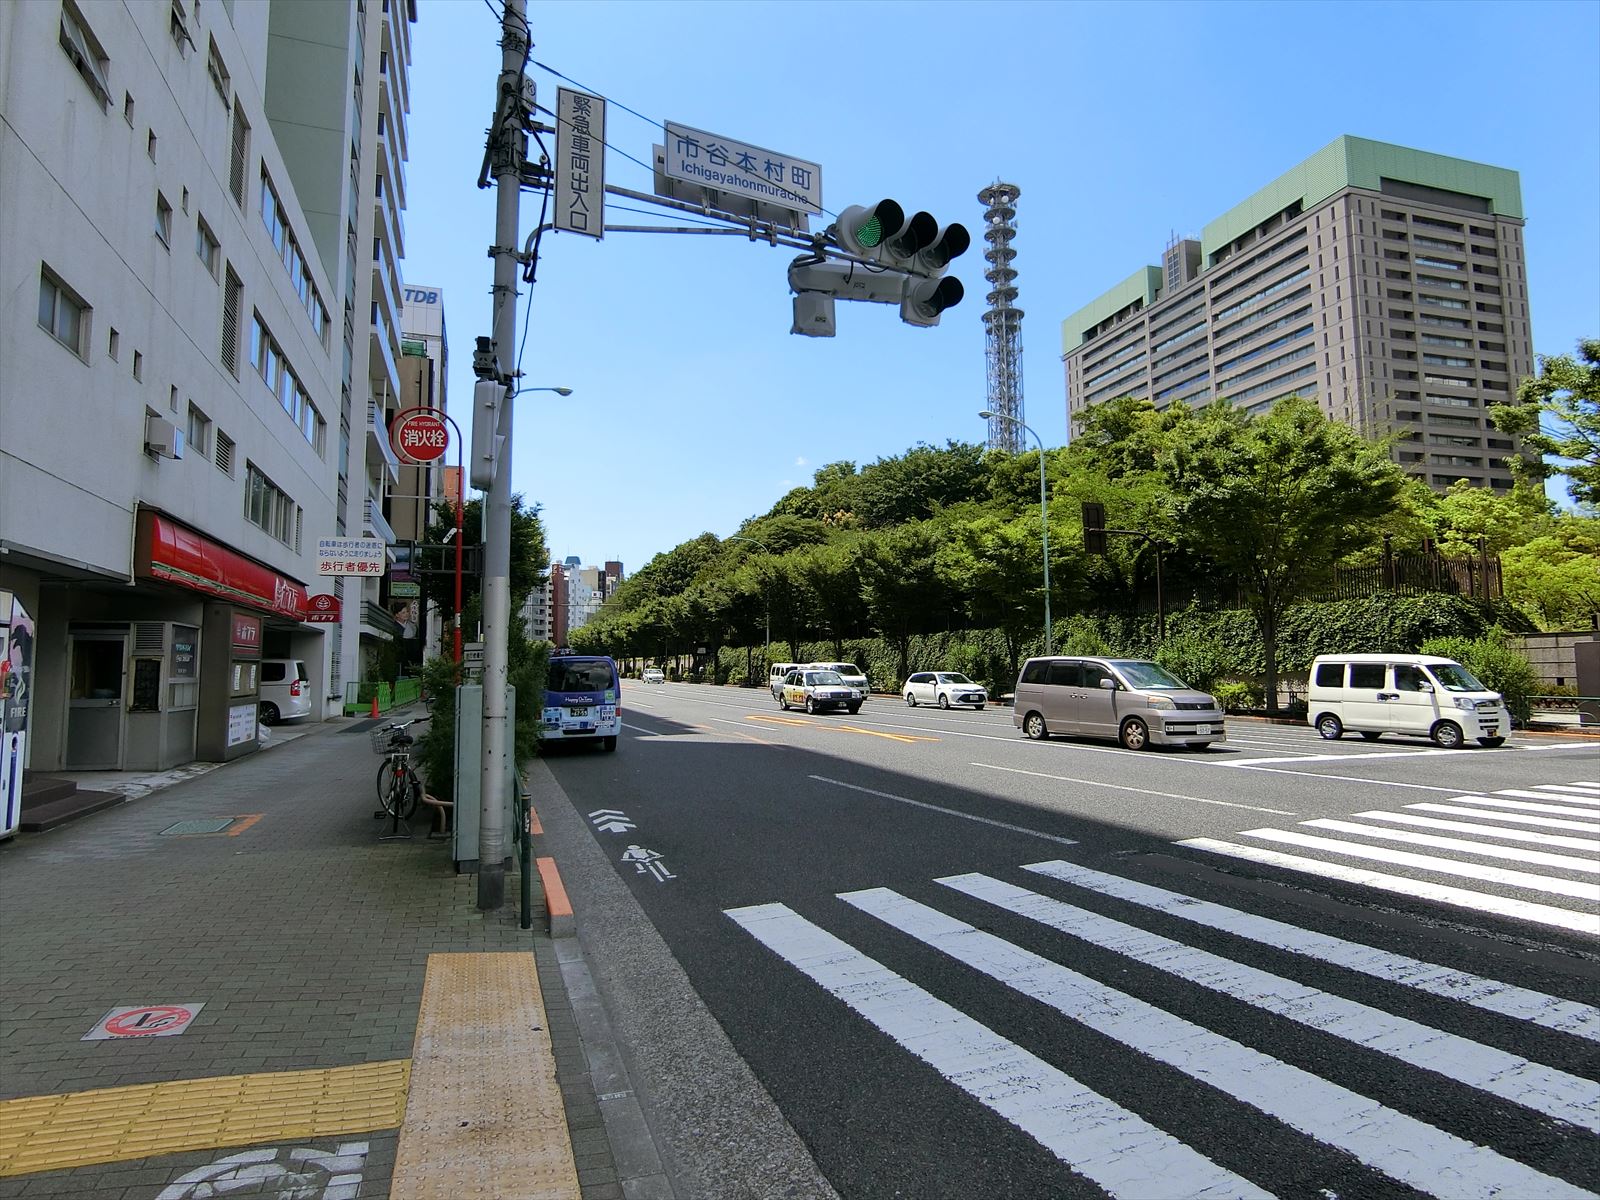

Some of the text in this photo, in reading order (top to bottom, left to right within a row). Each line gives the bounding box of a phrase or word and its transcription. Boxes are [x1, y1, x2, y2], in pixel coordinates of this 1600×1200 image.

[569, 95, 591, 231] 緊急車両出入口
[677, 135, 812, 191] 市谷本村町
[681, 160, 808, 204] Ichigayahonmuracho
[404, 288, 438, 304] TDB
[404, 429, 445, 447] 消火栓
[320, 561, 380, 573] 歩行者優先
[10, 706, 26, 718] FIRE
